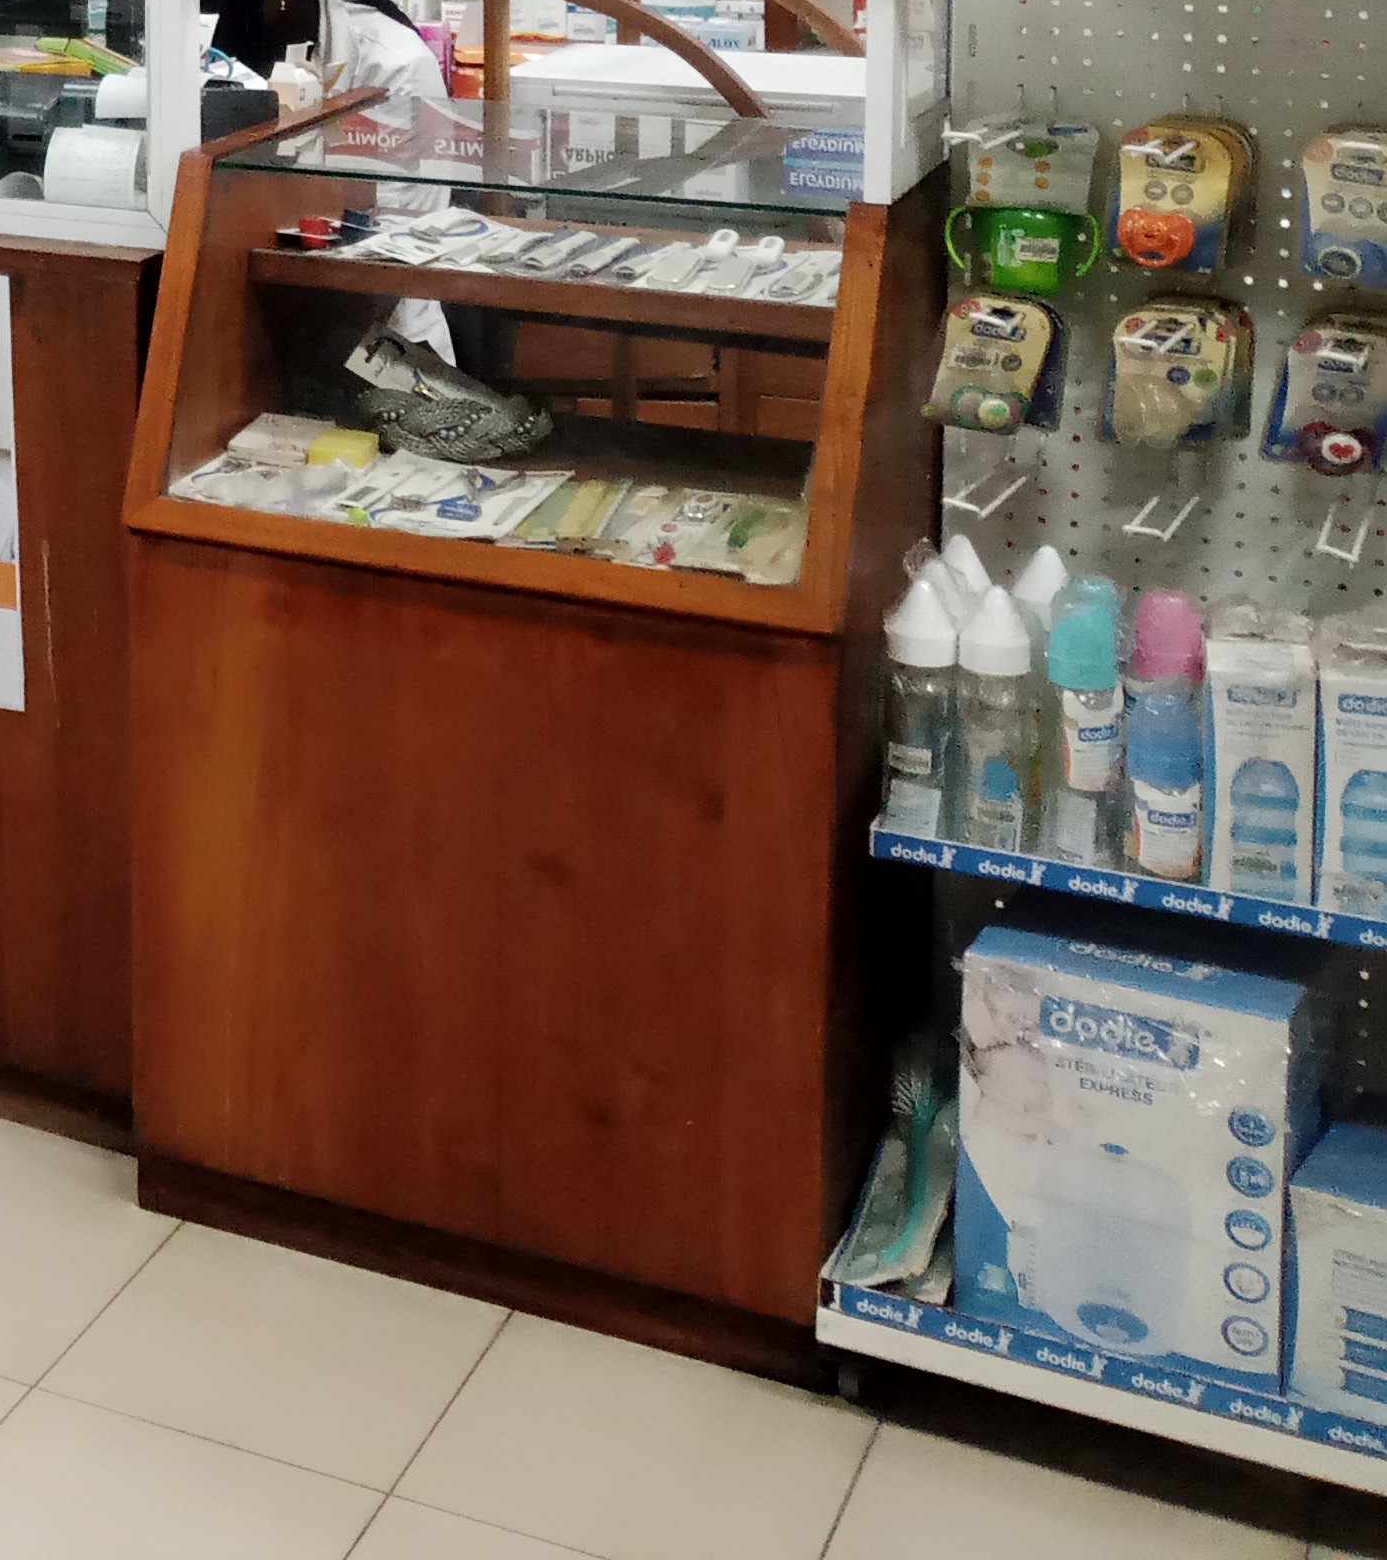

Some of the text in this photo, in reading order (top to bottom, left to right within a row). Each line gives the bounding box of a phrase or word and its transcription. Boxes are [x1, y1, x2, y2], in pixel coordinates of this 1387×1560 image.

[890, 843, 1312, 935] dodie dodie dodie dodie dodie
[1049, 1003, 1156, 1052] dodie
[1080, 1077, 1154, 1106] EXPRESS
[856, 1298, 905, 1323] dodie
[944, 1321, 994, 1347] dodie
[1036, 1346, 1087, 1373] dodie
[1131, 1373, 1185, 1399] dodie
[1229, 1398, 1284, 1426] dodie
